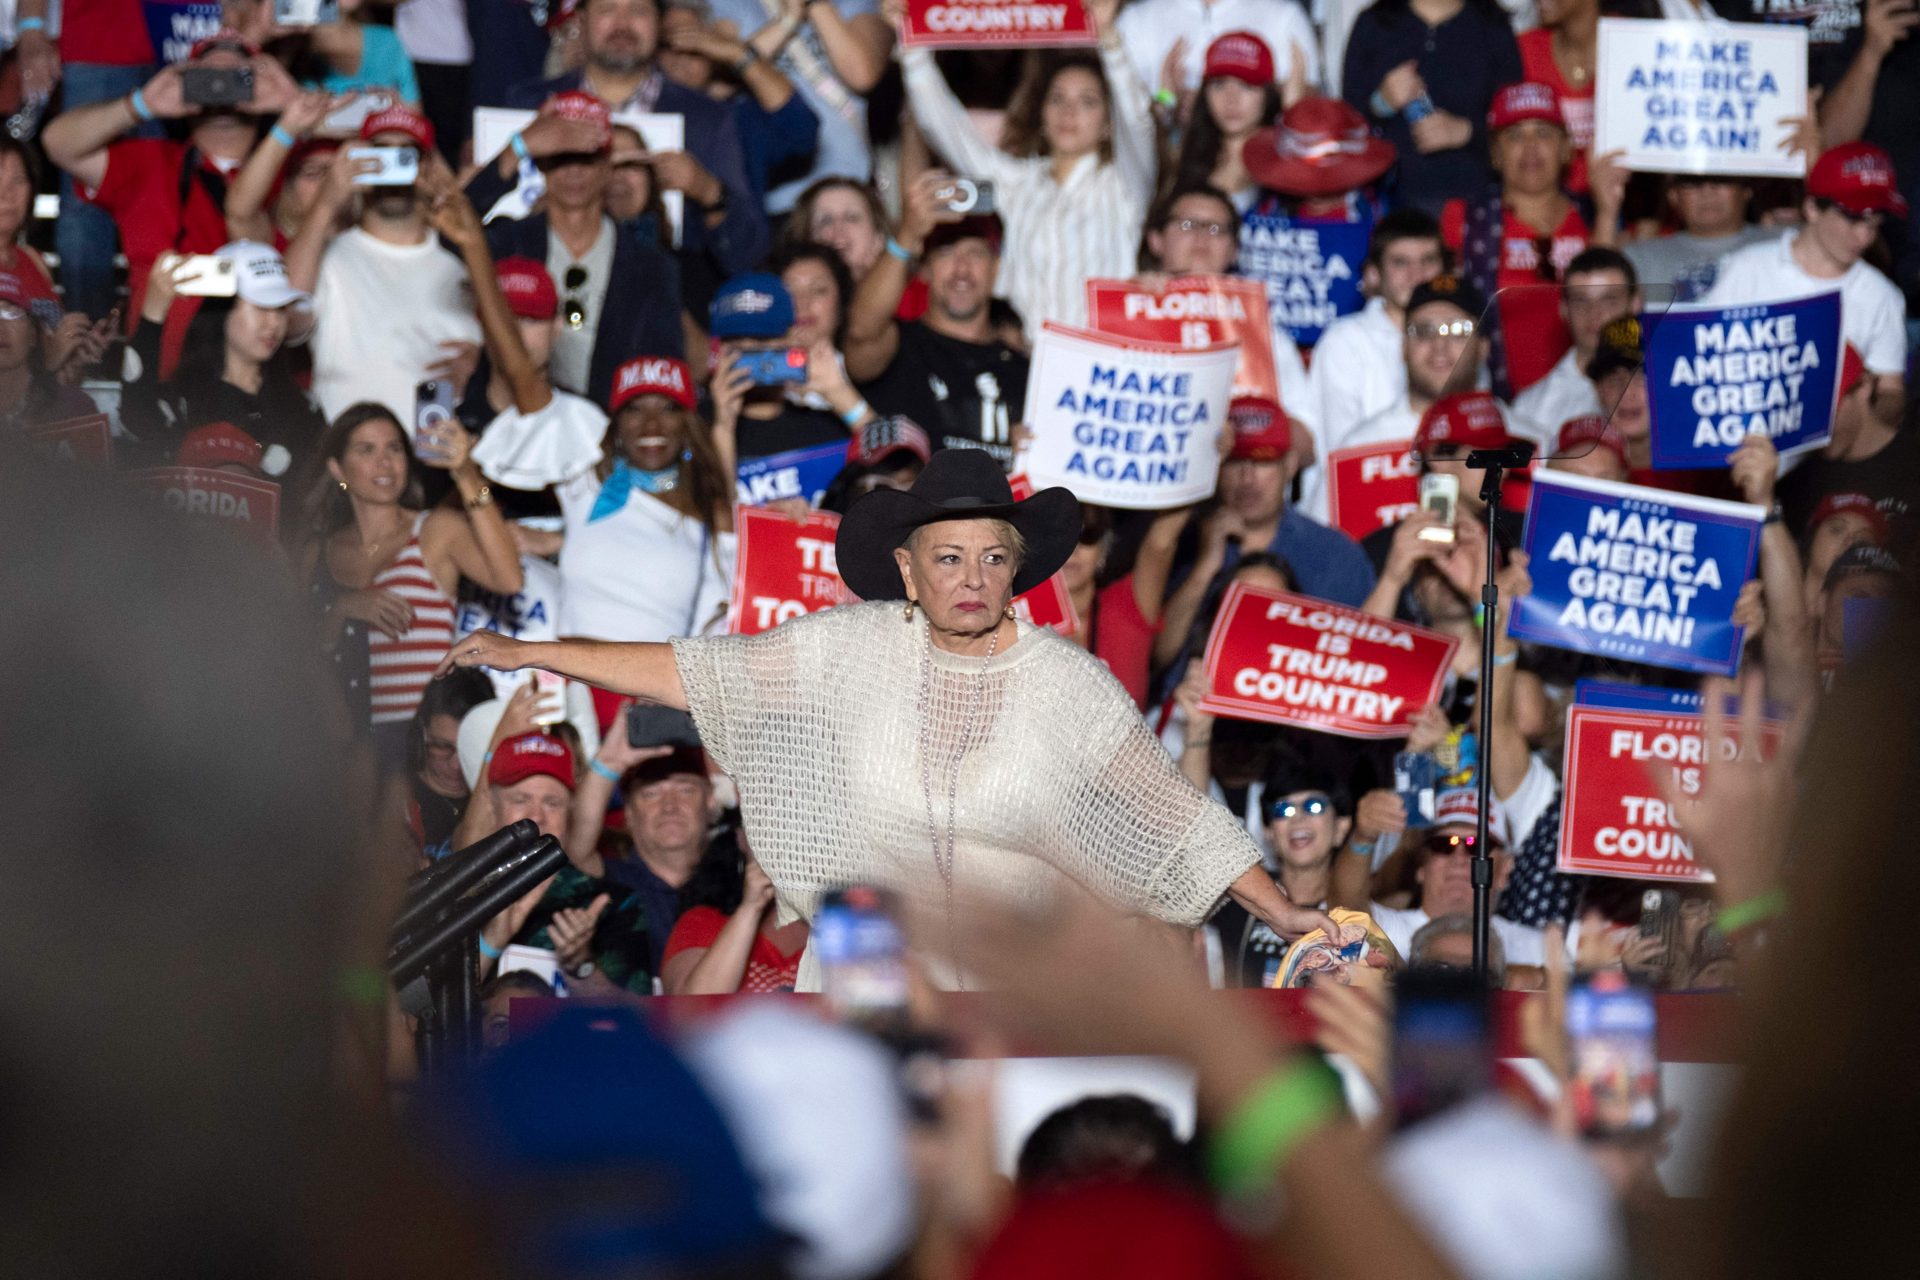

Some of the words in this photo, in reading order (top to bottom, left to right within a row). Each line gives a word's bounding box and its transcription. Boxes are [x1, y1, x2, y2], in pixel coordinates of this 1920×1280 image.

[924, 3, 1068, 33] COUNTRY
[1656, 39, 1752, 63] MAKE
[1627, 67, 1779, 95] AMERICA
[1646, 94, 1758, 120] GREAT
[1643, 125, 1762, 149] AGAIN!
[1123, 291, 1247, 321] FLORIDA
[1180, 320, 1212, 350] IS
[1693, 313, 1798, 354] MAKE
[617, 358, 686, 394] MAGA
[1090, 361, 1194, 398] MAKE
[1669, 340, 1821, 388] AMERICA
[1056, 387, 1210, 427] AMERICA
[1691, 372, 1805, 417] GREAT
[1072, 420, 1193, 455] GREAT
[1692, 401, 1804, 448] AGAIN!
[1065, 450, 1190, 486] AGAIN!
[1586, 505, 1698, 553] MAKE
[1548, 531, 1722, 591] AMERICA
[1567, 566, 1698, 616] GREAT
[751, 595, 808, 630] TO
[1265, 600, 1415, 652] FLORIDA
[1557, 596, 1696, 649] AGAIN!
[1315, 631, 1353, 656] IS
[1267, 642, 1389, 688] TRUMP
[1233, 666, 1404, 723] COUNTRY
[1671, 766, 1702, 795] IS
